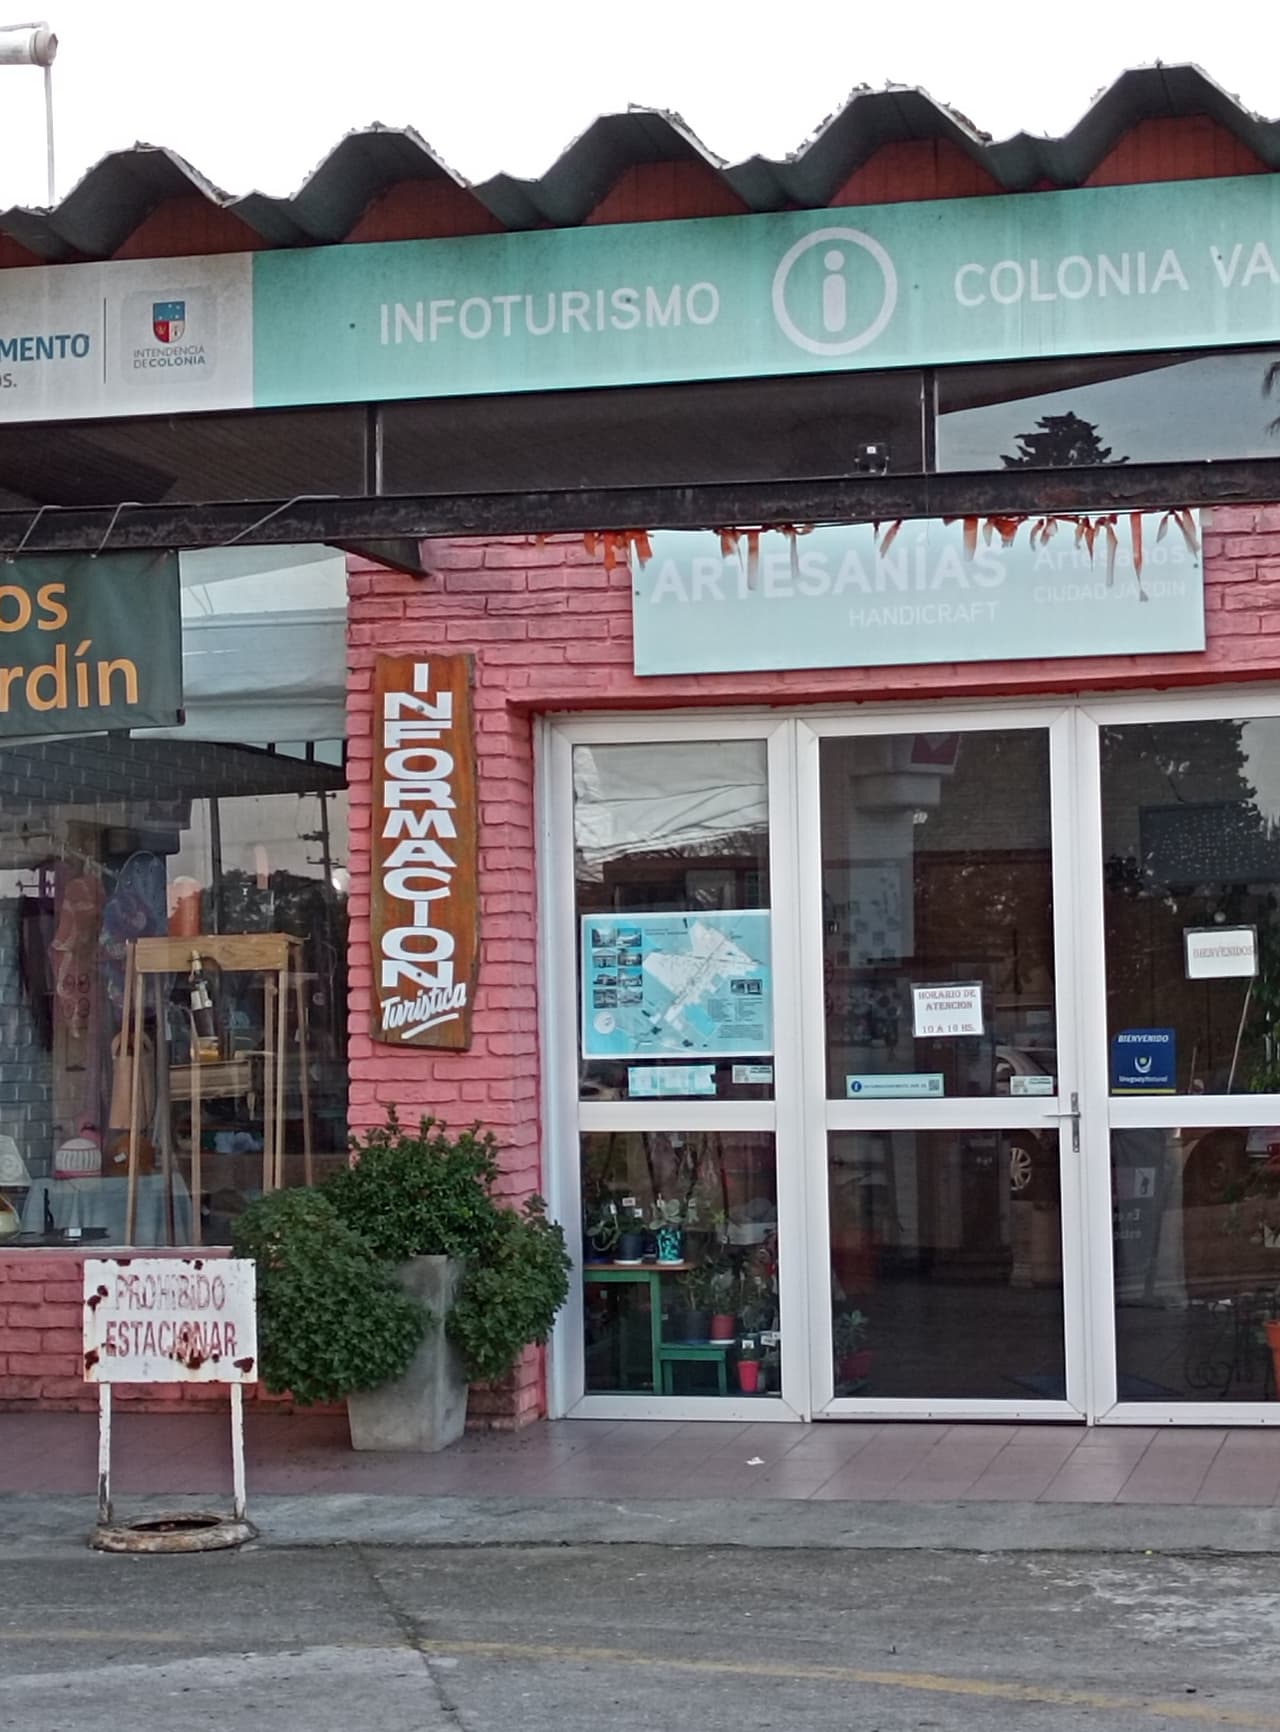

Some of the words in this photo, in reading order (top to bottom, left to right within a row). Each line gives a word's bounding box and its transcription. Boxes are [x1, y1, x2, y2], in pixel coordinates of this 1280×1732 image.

[380, 281, 720, 346] INFOTURISMO
[954, 248, 1189, 308] COLONIA
[133, 345, 206, 358] INTENDENCIA
[848, 600, 999, 629] HANDICRAFT
[381, 663, 458, 988] INFORMACION
[918, 990, 961, 1000] HORARIO
[964, 989, 977, 998] DE
[1117, 1034, 1169, 1044] BIENVENIDO
[115, 1274, 226, 1311] PROHIBIDO
[105, 1320, 238, 1358] ESTACIONAR
